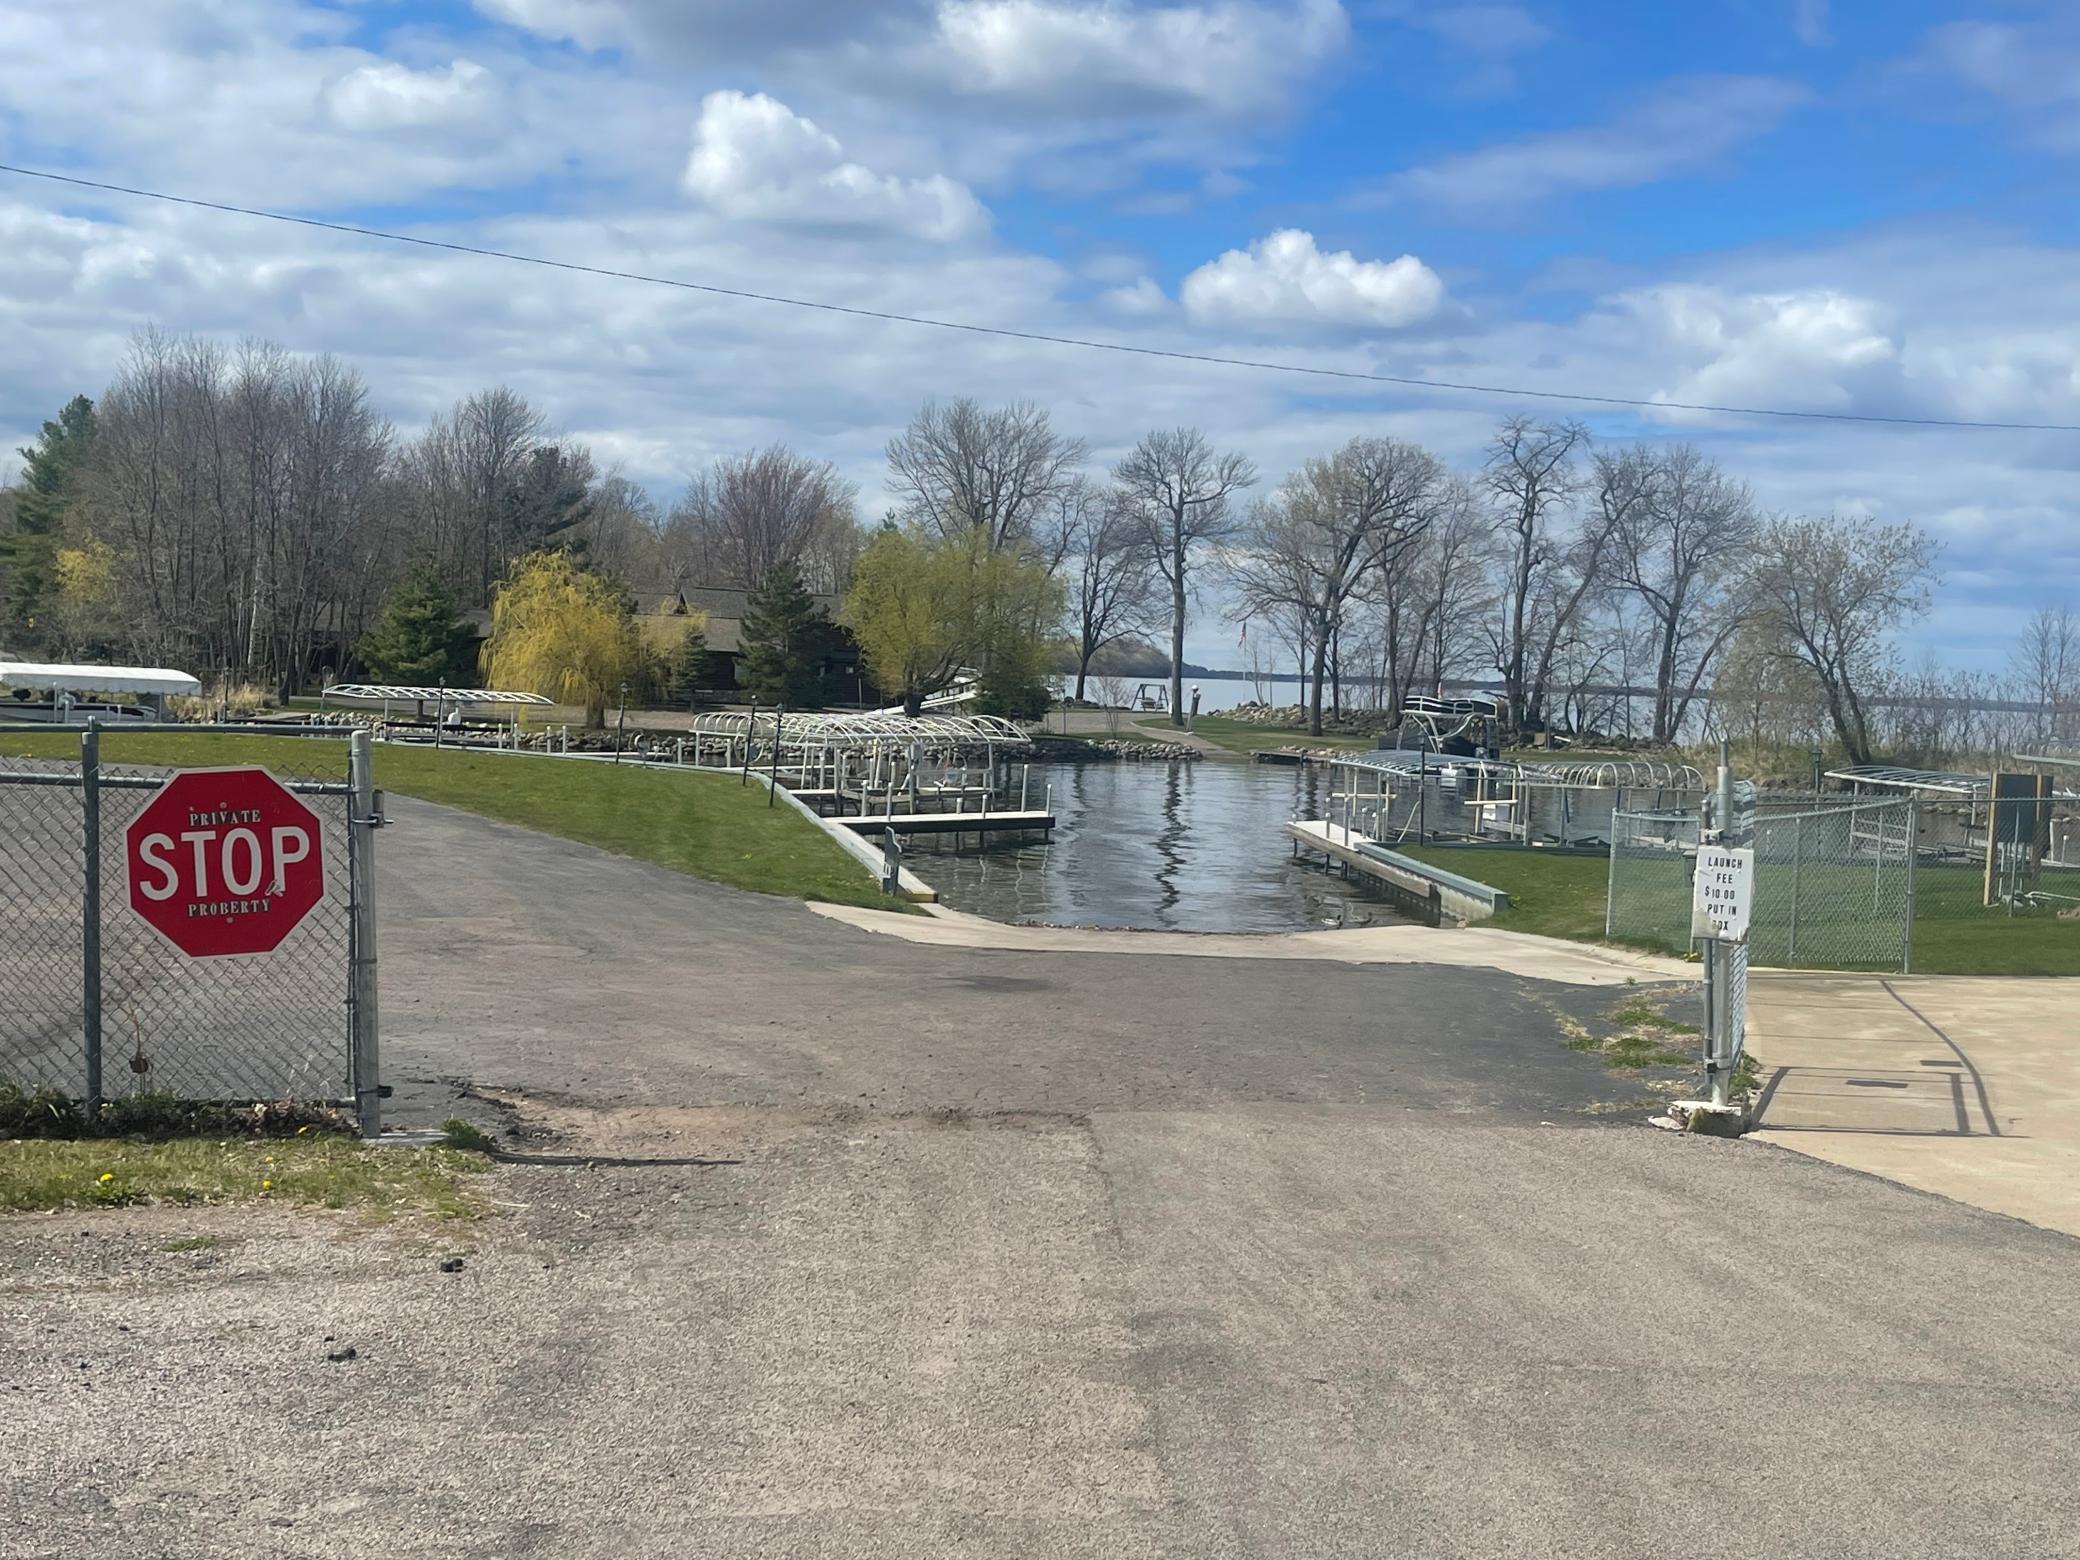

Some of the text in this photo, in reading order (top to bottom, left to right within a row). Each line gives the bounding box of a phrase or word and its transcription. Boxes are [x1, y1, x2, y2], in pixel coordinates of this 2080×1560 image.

[190, 810, 261, 826] PRIVATE
[139, 826, 310, 901] STOP
[1708, 857, 1742, 868] LAUNCH
[1716, 873, 1733, 884] FEE
[1707, 904, 1736, 915] PUT IN
